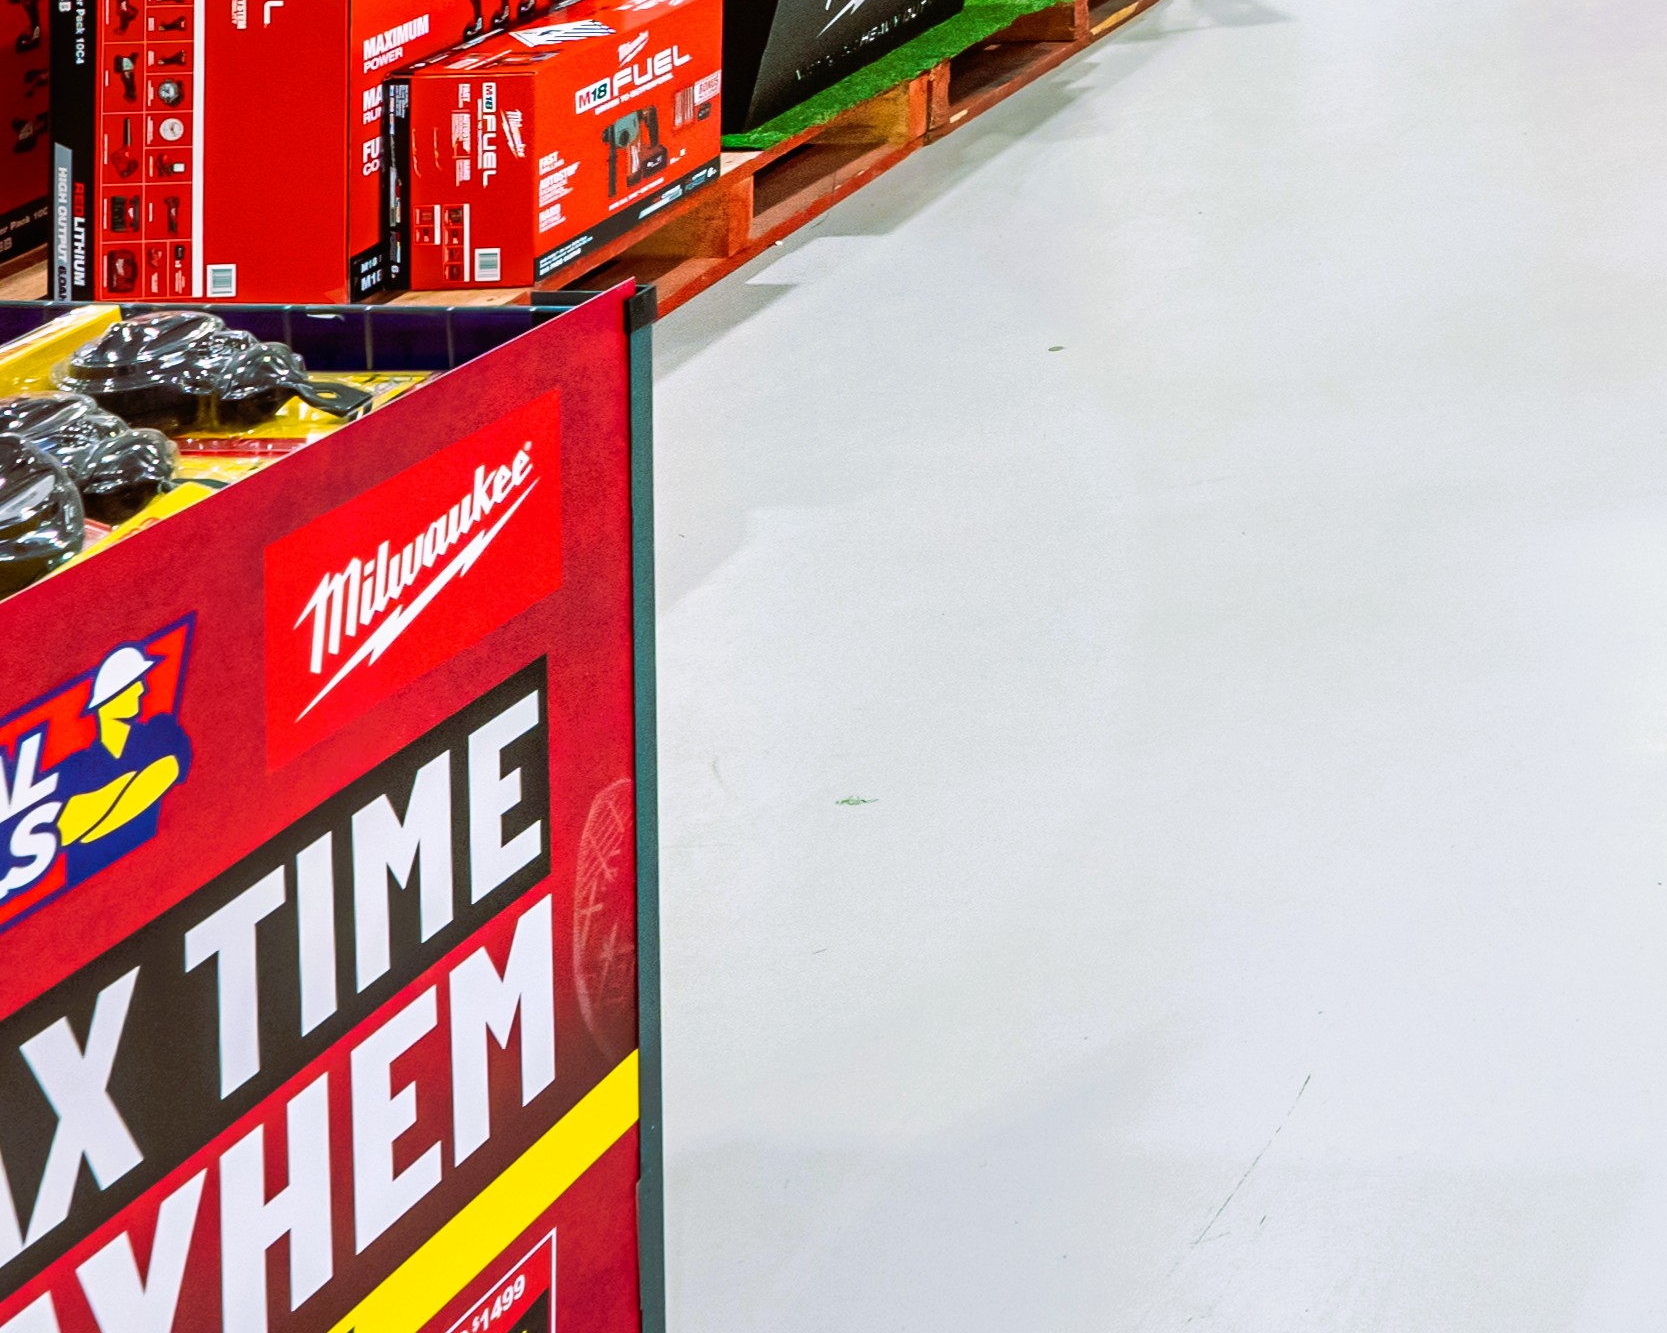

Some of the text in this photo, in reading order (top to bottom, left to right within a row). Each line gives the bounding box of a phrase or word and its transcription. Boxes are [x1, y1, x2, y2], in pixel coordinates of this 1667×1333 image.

[76, 8, 85, 35] Pack
[363, 14, 429, 61] MAXIMUM
[363, 48, 403, 74] POWER
[578, 45, 692, 108] M18 FUEL
[58, 167, 68, 262] HIGH OUTPUT
[293, 441, 533, 675] Milwaukee
[184, 689, 543, 1100] TIME
[471, 1274, 526, 1332] $1499
